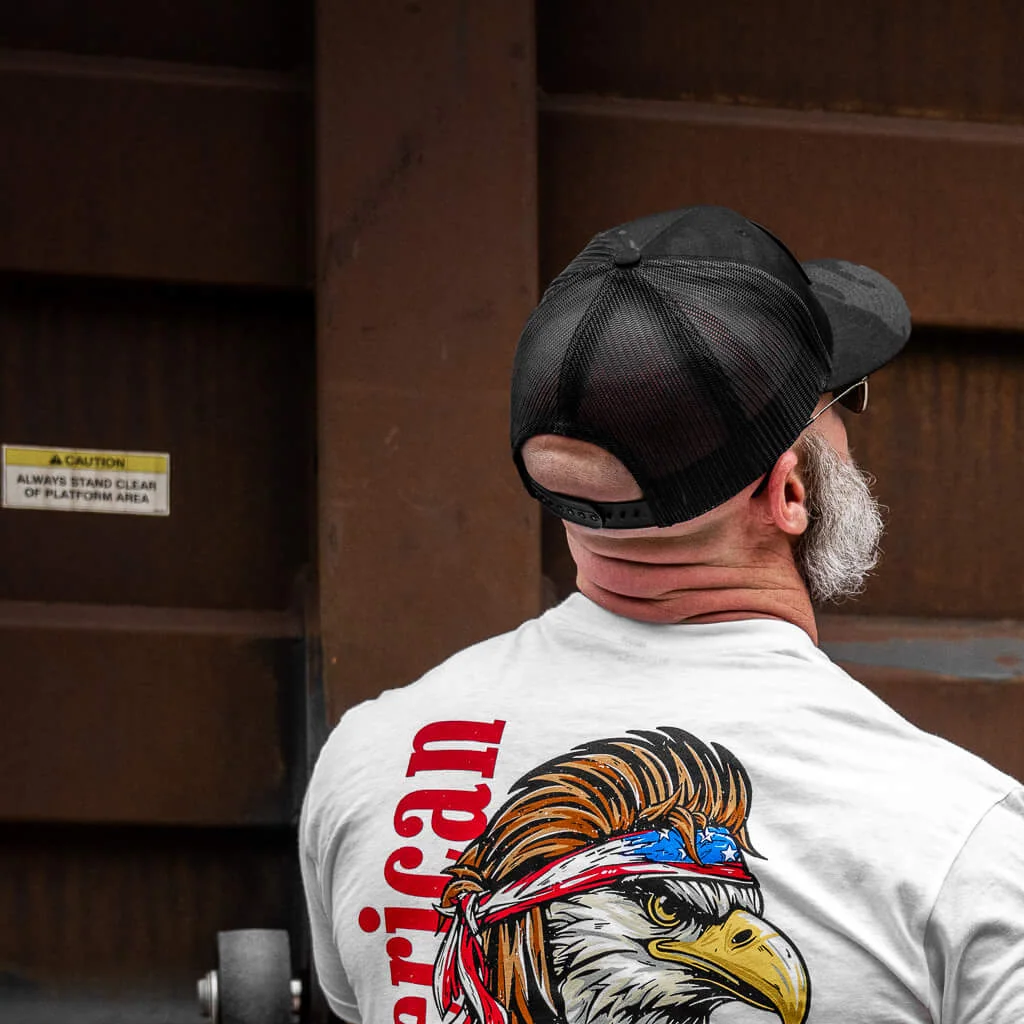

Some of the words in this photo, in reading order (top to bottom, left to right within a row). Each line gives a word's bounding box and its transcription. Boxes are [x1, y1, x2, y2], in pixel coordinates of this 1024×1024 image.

[65, 455, 126, 468] CAUTION
[17, 474, 67, 487] ALWAYS
[71, 476, 112, 489] STAND
[115, 479, 157, 491] CLEAR
[24, 487, 41, 498] OF
[44, 488, 113, 502] PLATFORM
[115, 493, 150, 504] AREA
